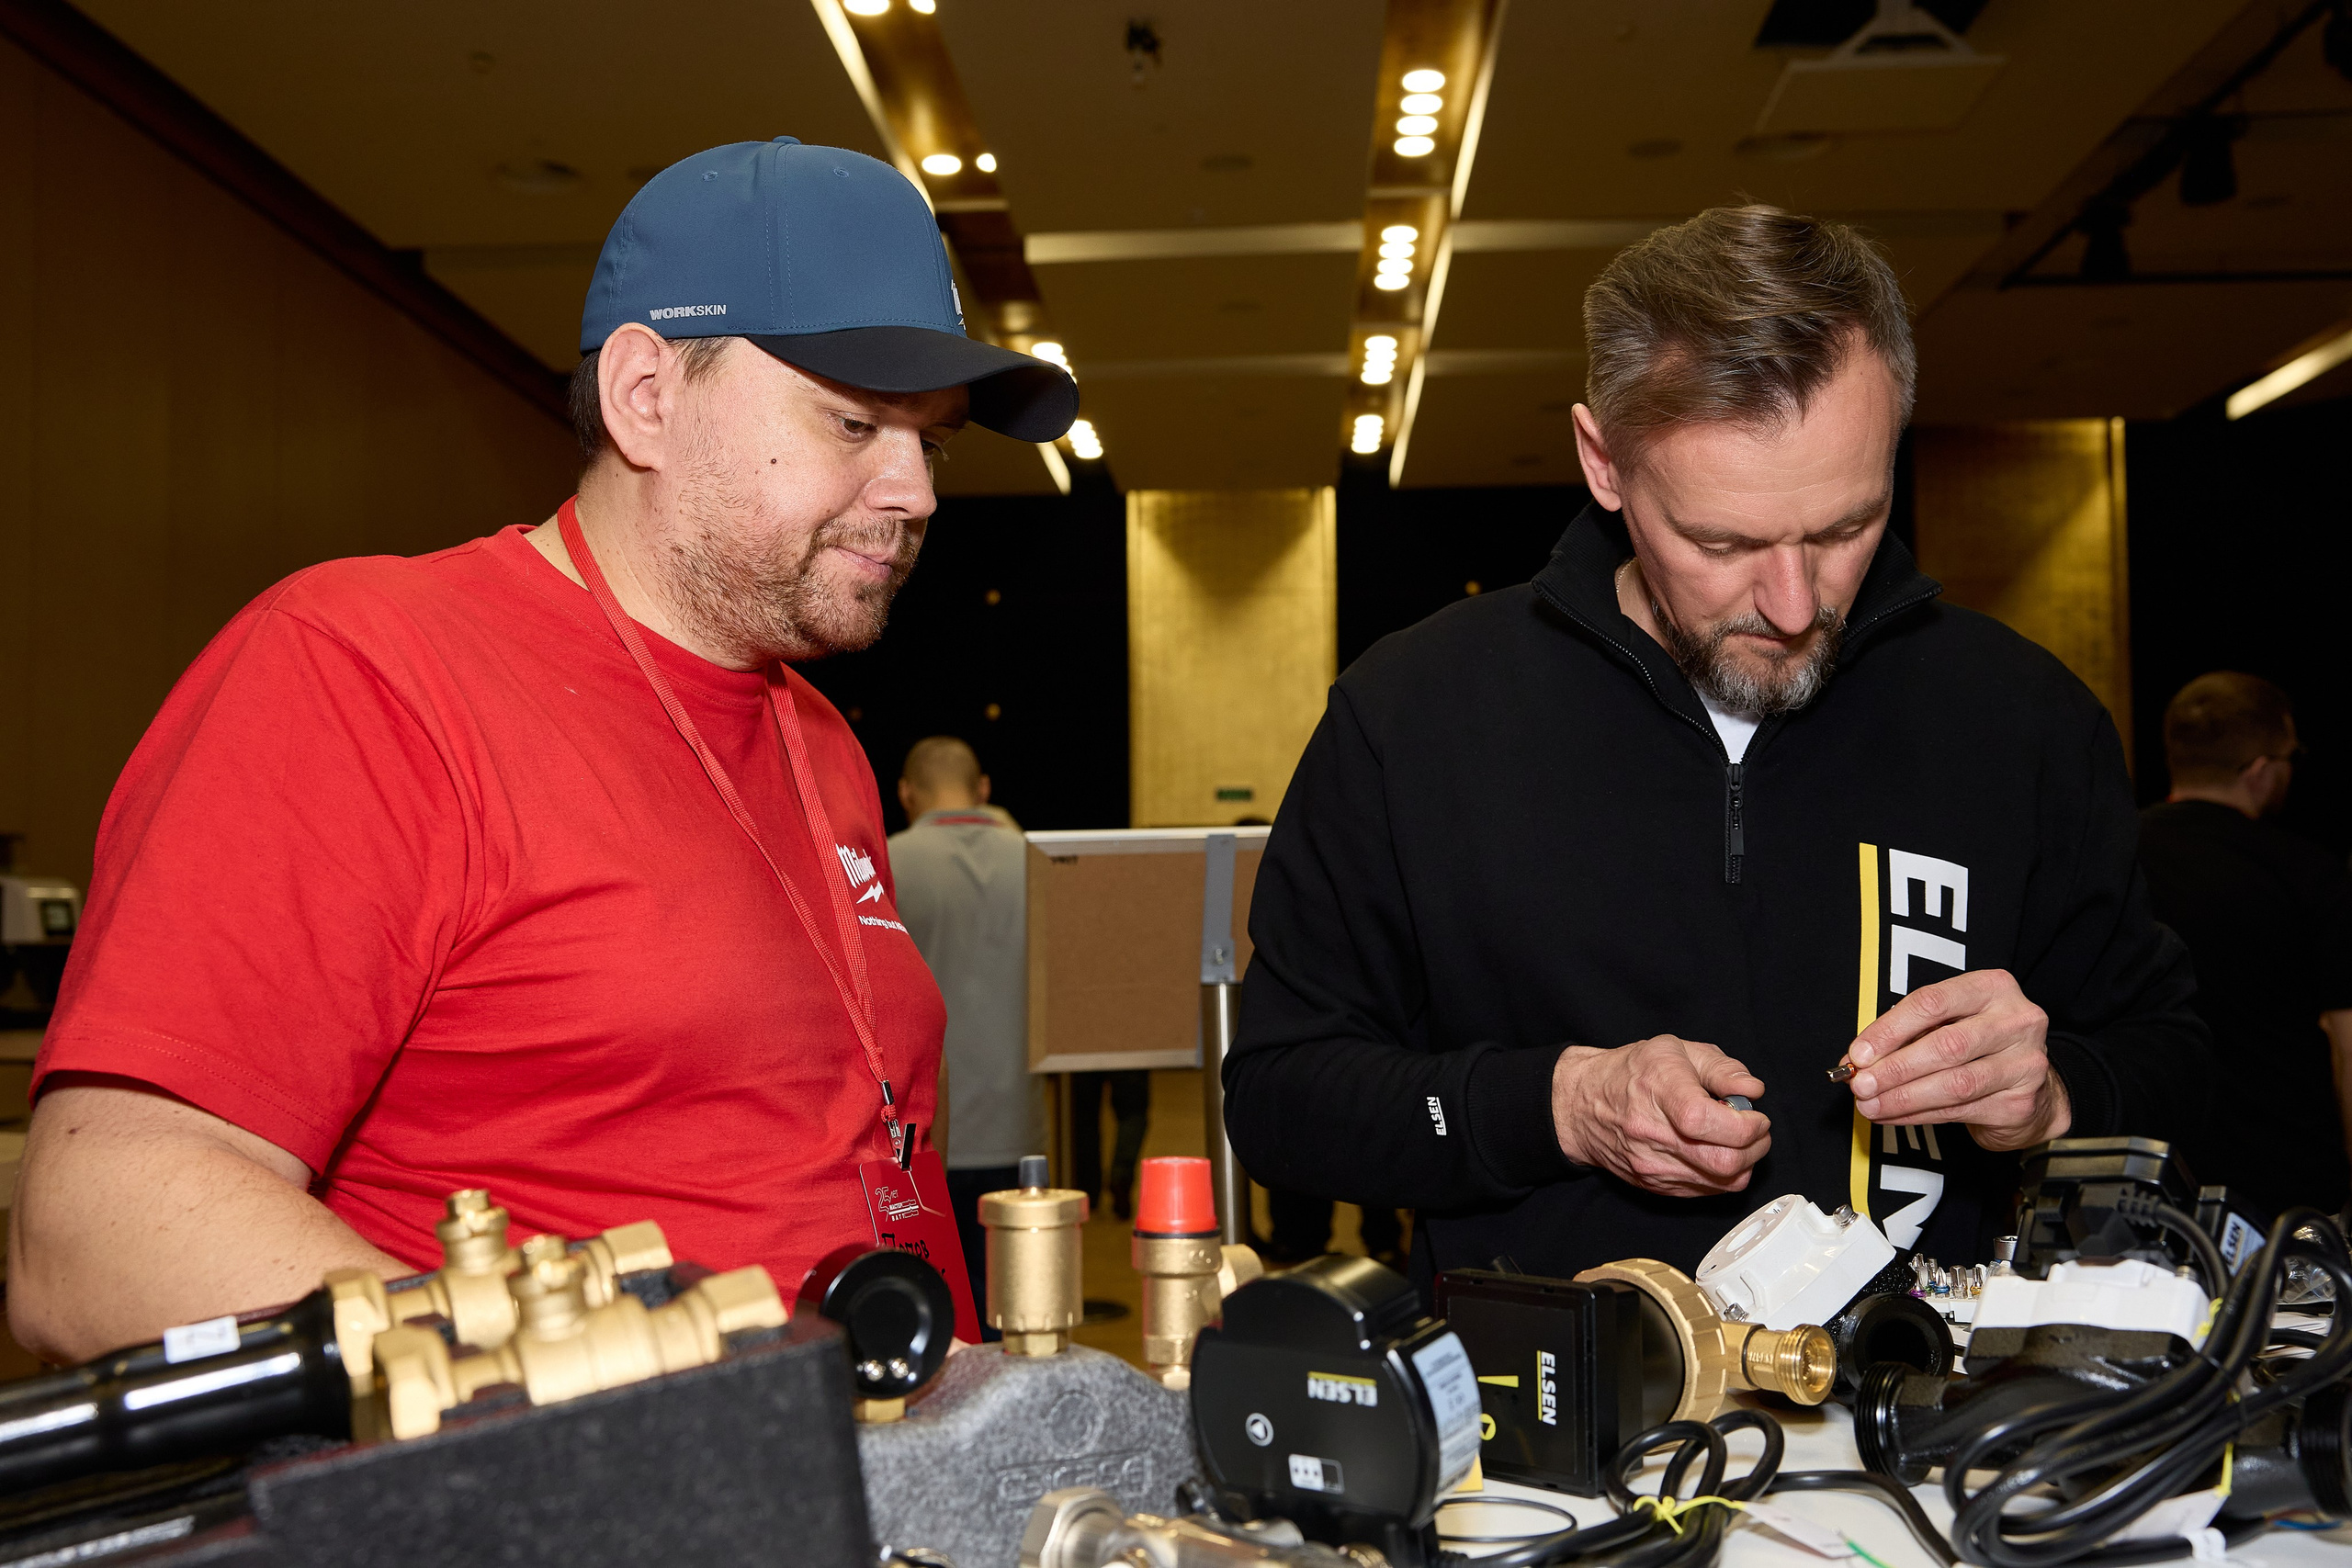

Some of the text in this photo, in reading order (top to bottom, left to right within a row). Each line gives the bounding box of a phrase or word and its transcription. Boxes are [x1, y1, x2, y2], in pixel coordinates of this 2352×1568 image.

[650, 304, 727, 320] WORKSKIN
[1879, 848, 1969, 1251] ELN
[1426, 1096, 1445, 1135] ELSEN
[1307, 1377, 1378, 1407] ELSEN
[1541, 1350, 1557, 1426] ELSEN
